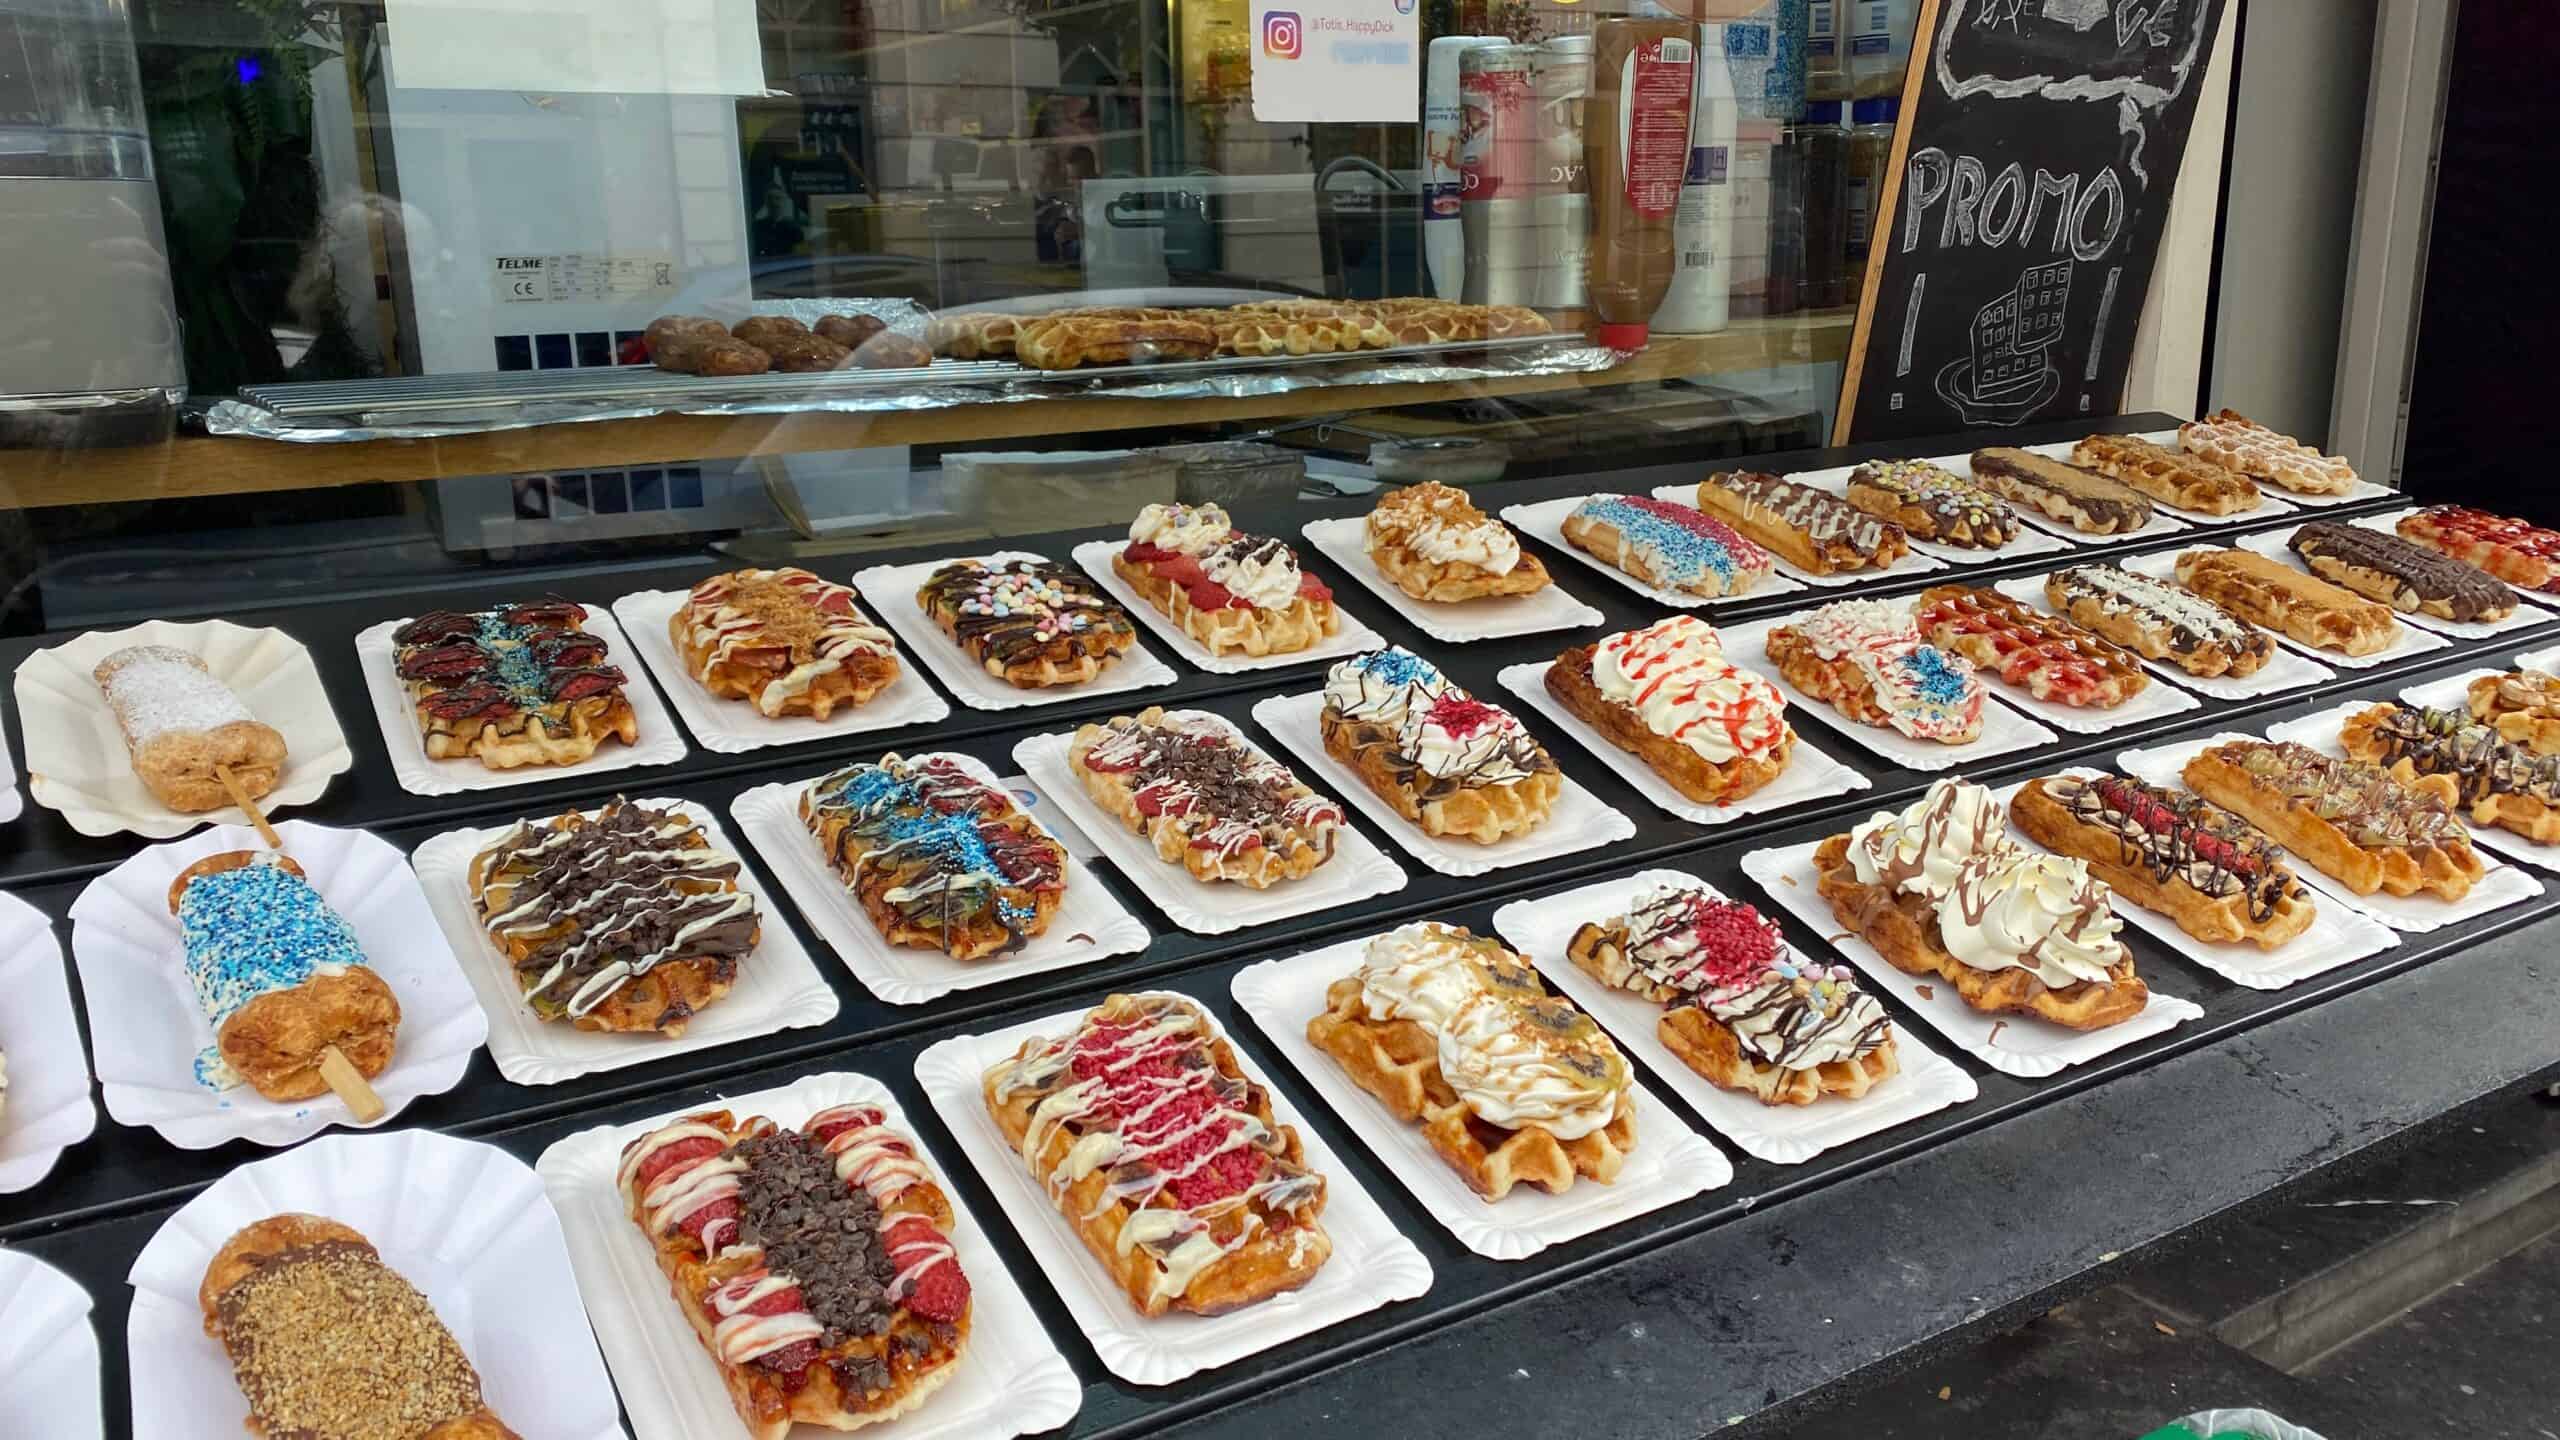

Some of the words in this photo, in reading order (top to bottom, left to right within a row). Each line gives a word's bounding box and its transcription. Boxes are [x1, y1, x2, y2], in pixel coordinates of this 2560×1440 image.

[1551, 166, 1584, 183] AC
[1903, 147, 2123, 260] PROMO
[496, 258, 544, 269] TELME
[514, 282, 534, 295] CE
